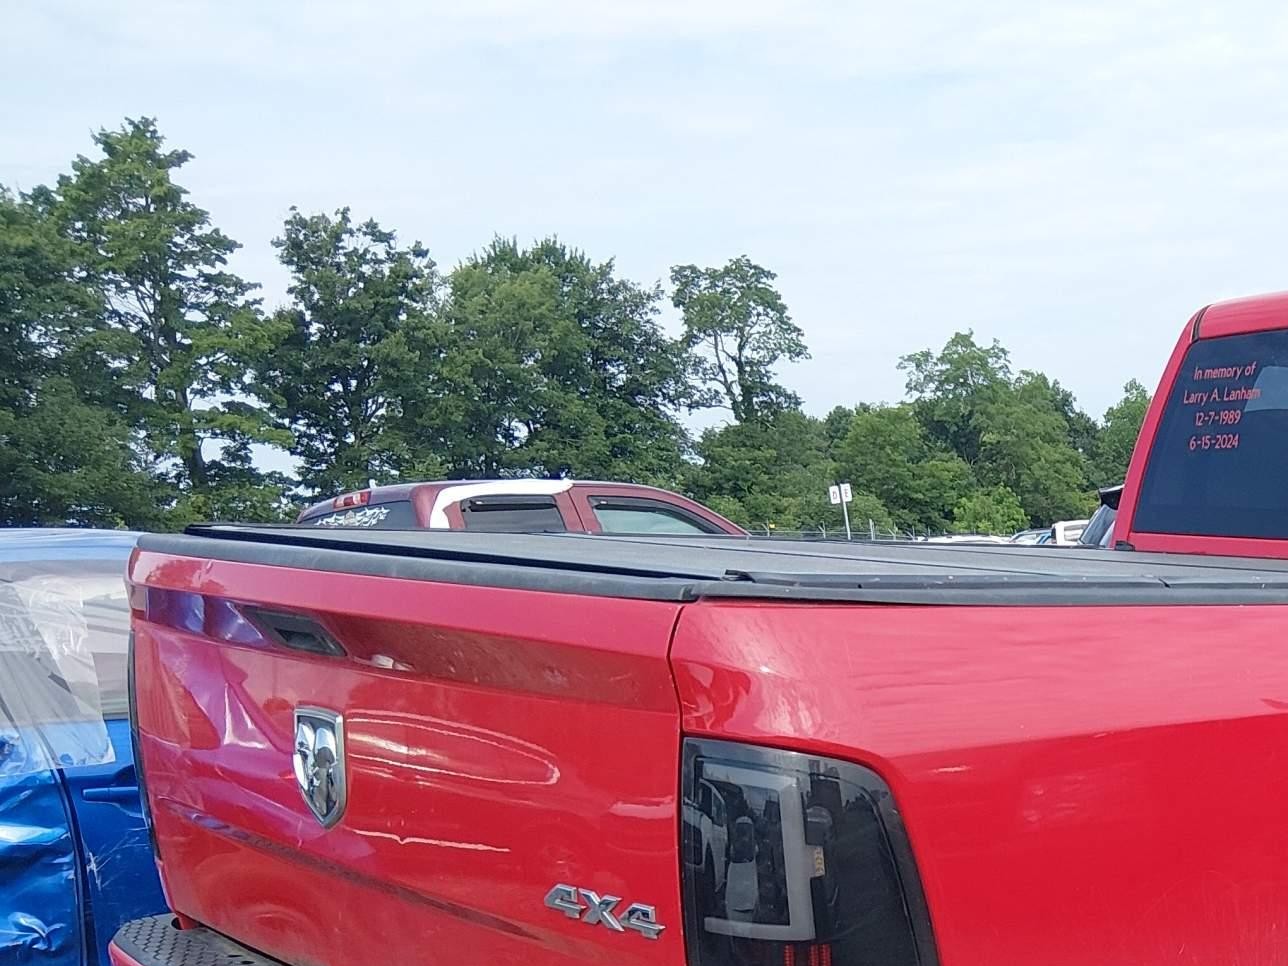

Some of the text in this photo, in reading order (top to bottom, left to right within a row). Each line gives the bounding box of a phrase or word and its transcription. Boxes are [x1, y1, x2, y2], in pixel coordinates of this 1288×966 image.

[1194, 361, 1257, 380] In memory of
[1183, 386, 1262, 406] Larry A. Lanham
[1195, 410, 1242, 426] 12-7-1989
[1189, 433, 1239, 450] 6-15-2024
[543, 883, 666, 940] 4X4
